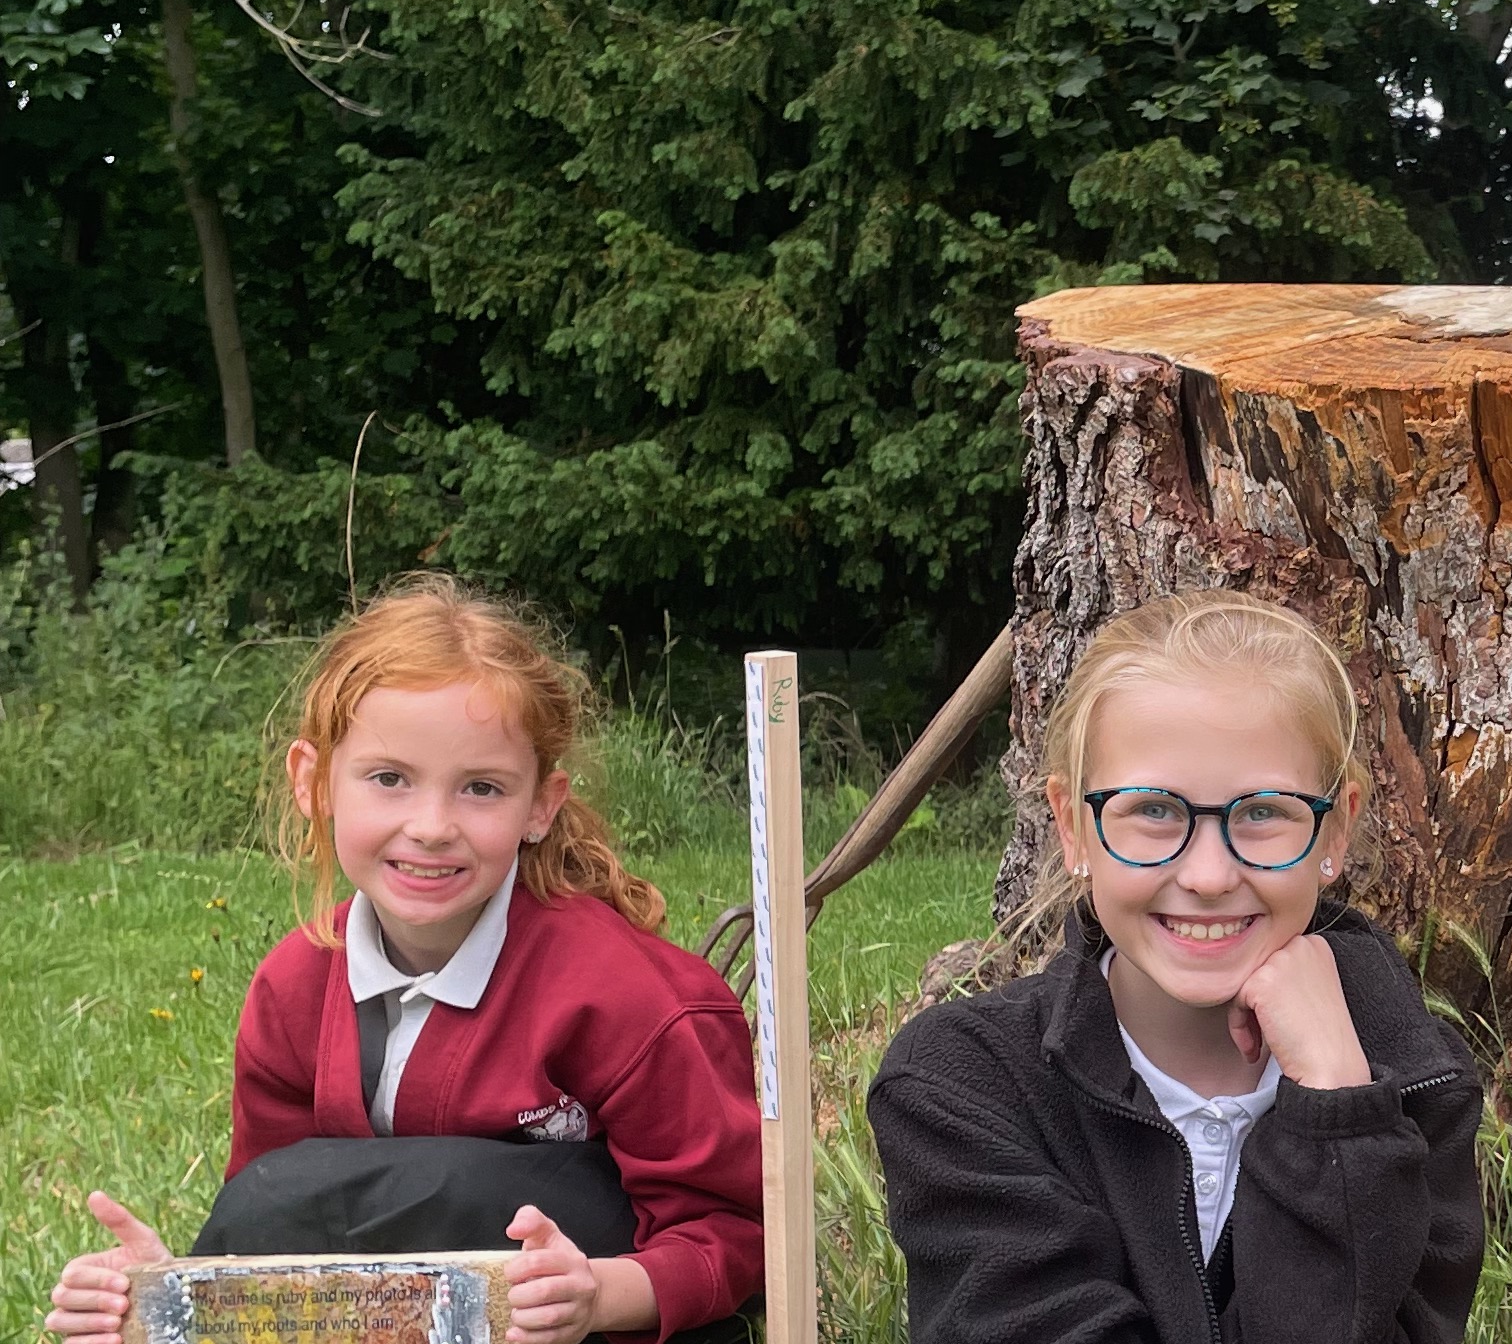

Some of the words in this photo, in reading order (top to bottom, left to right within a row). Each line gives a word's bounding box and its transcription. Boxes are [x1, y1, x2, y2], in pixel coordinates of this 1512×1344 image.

[768, 676, 793, 724] Ruby
[219, 1293, 257, 1306] name
[261, 1291, 272, 1305] is
[310, 1289, 337, 1304] and
[340, 1288, 362, 1307] my
[366, 1287, 405, 1307] photo
[409, 1285, 421, 1300] is
[195, 1320, 235, 1335] about
[239, 1320, 261, 1336] my
[263, 1318, 298, 1333] roots
[301, 1316, 328, 1331] and
[331, 1315, 360, 1330] who
